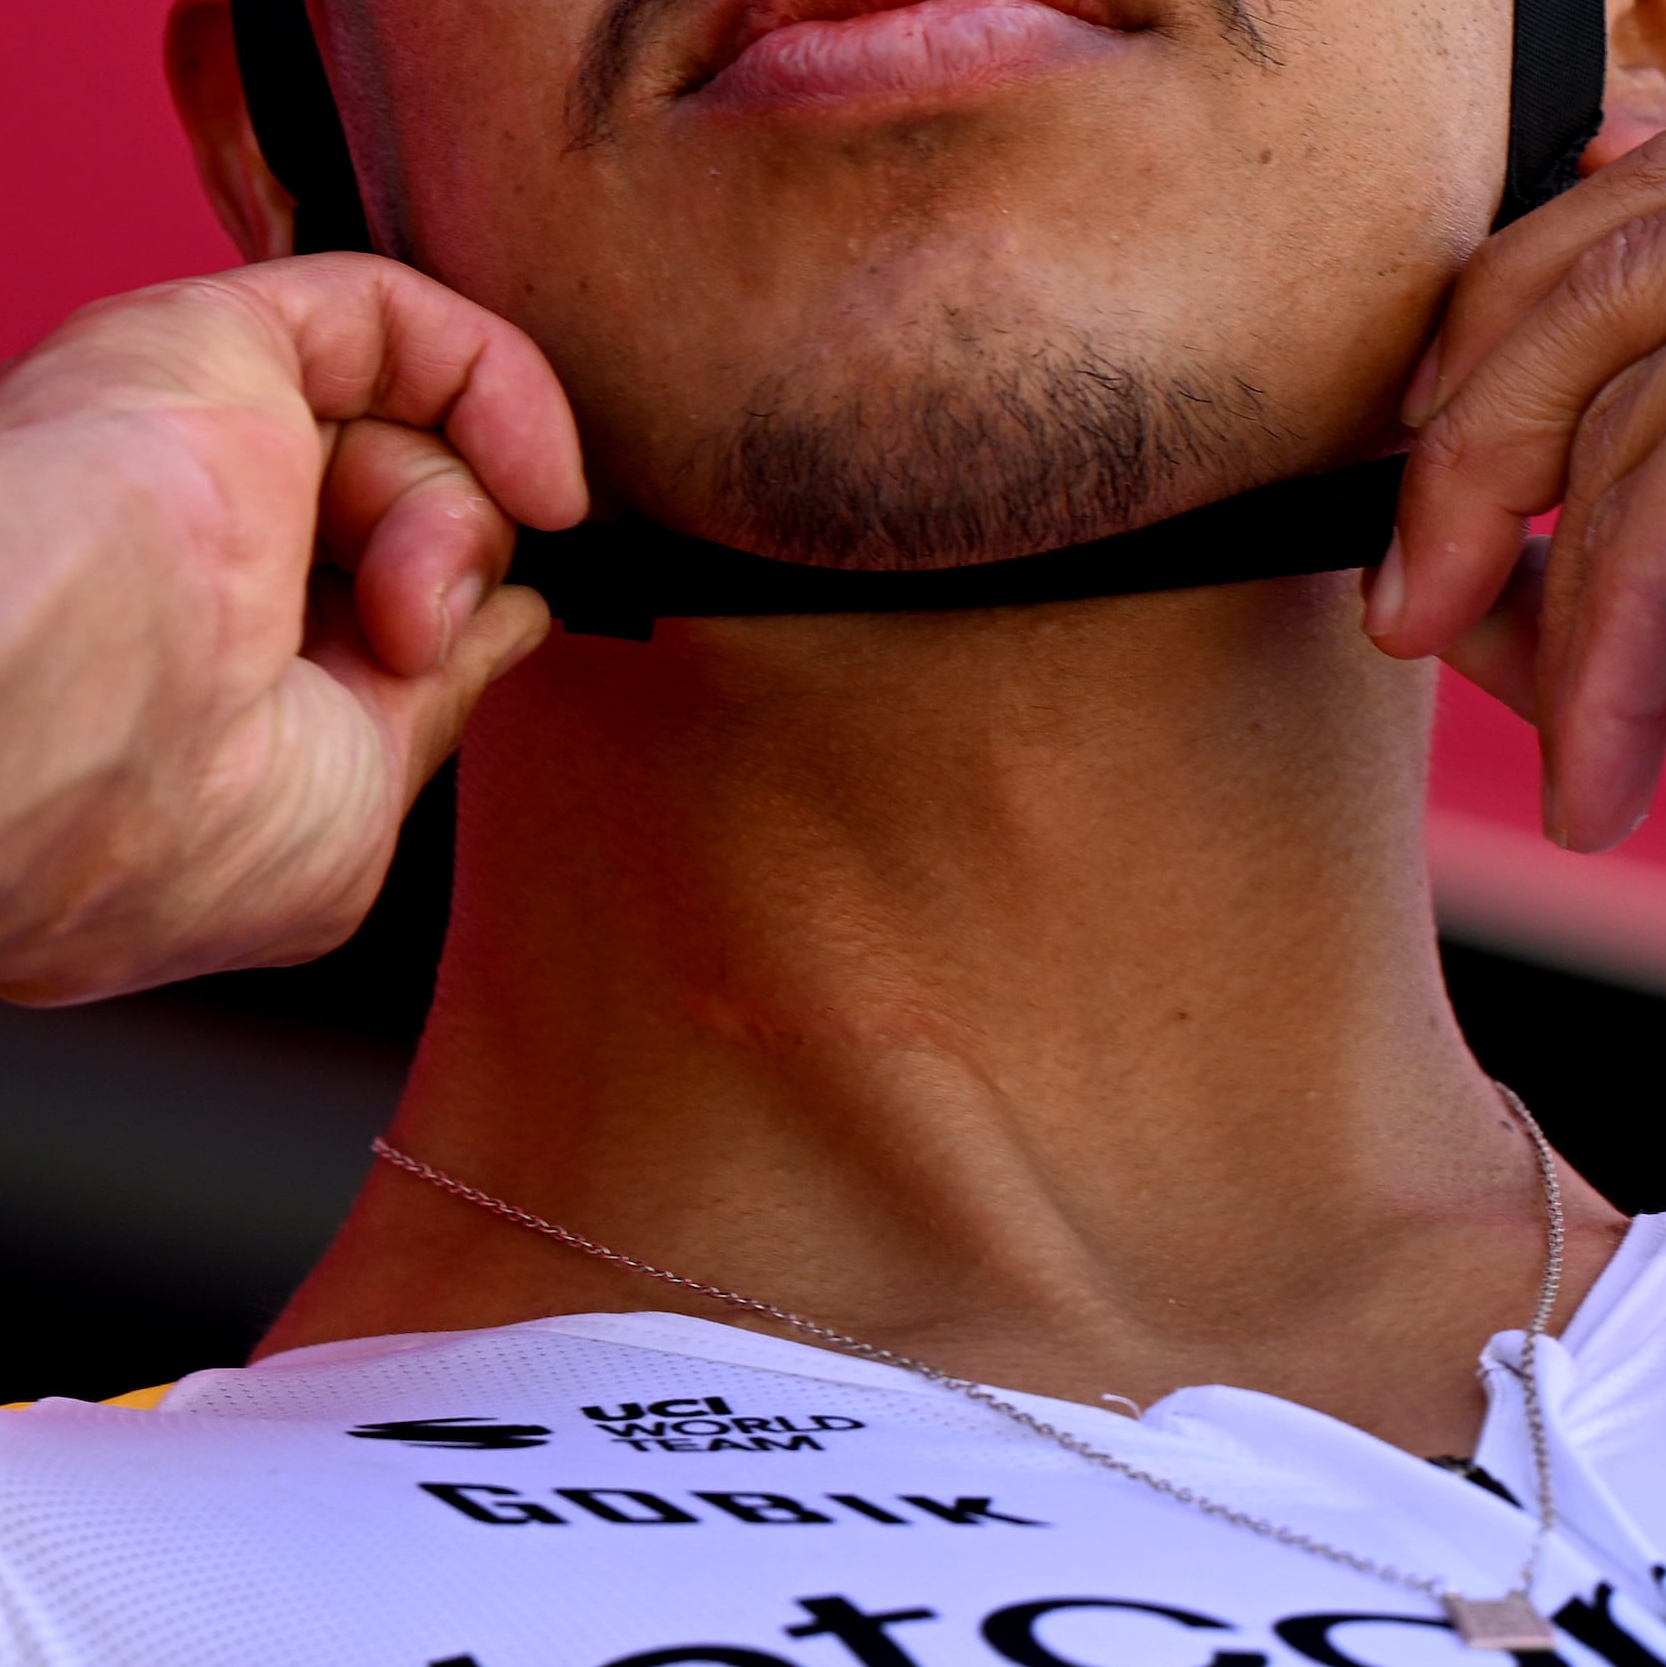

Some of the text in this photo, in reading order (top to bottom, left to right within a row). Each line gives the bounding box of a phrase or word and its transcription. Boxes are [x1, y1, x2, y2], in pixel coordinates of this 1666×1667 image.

[579, 1395, 734, 1422] UCI
[594, 1415, 867, 1438] WORLD
[610, 1435, 826, 1453] TEAM
[417, 1481, 1055, 1527] GOBIK
